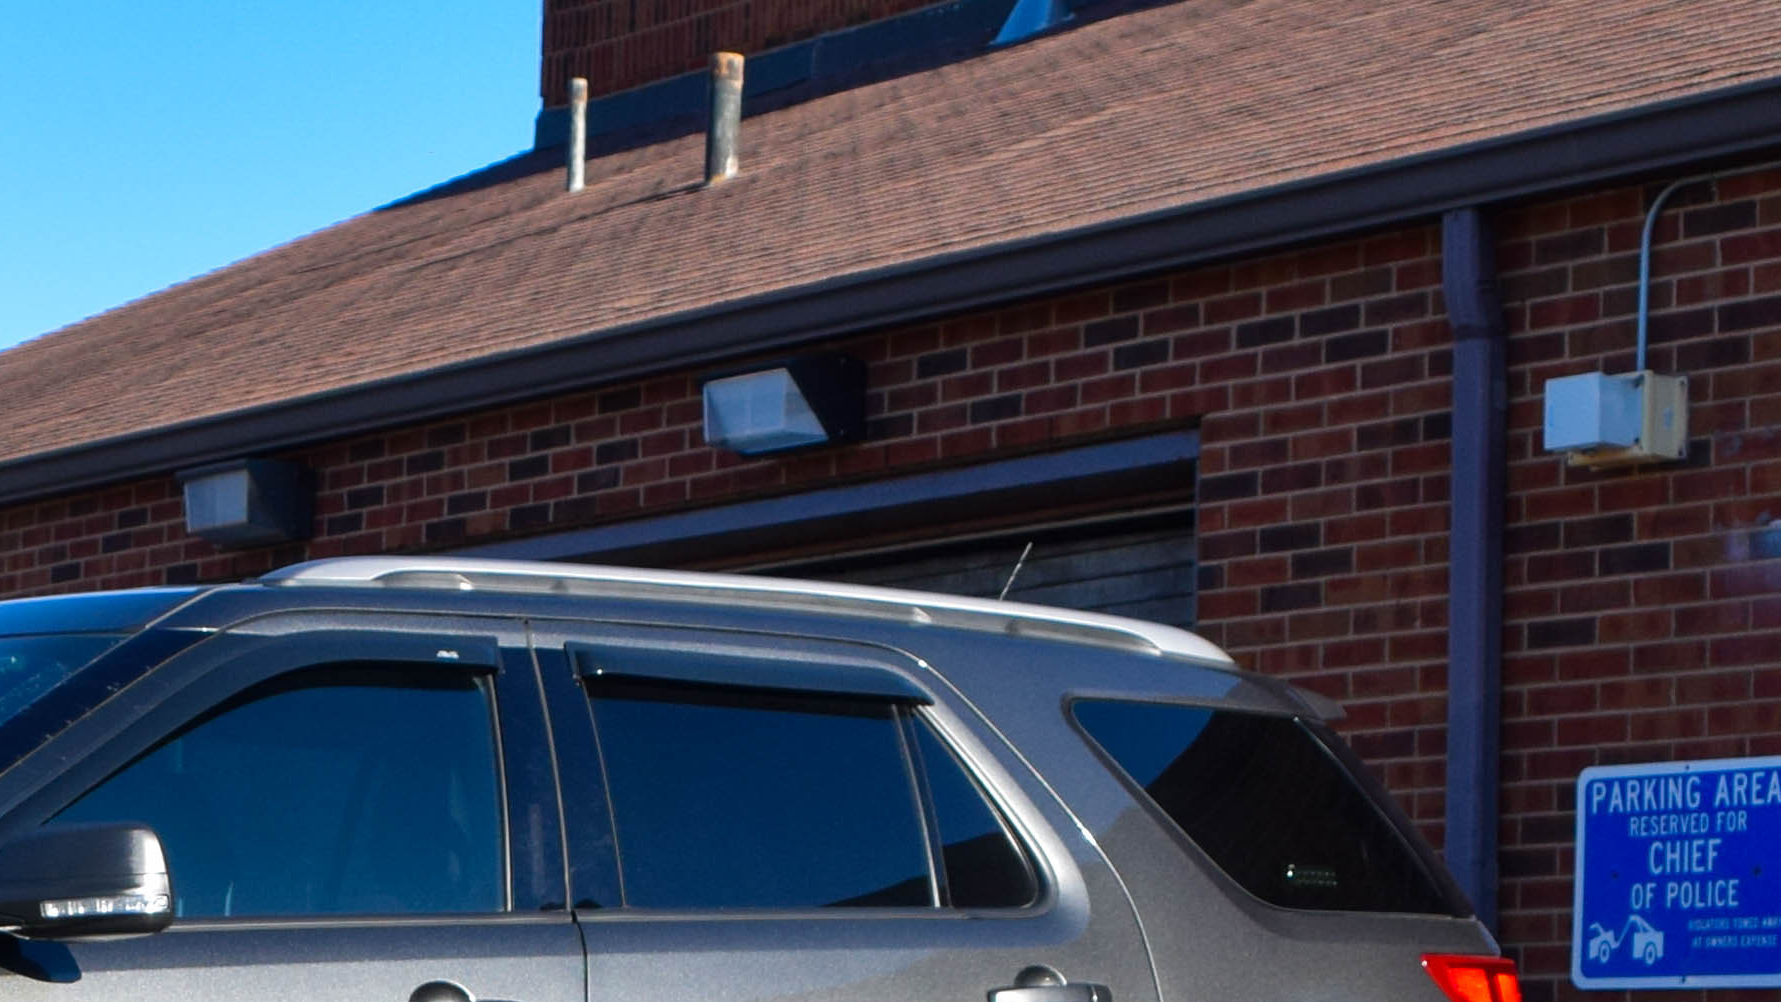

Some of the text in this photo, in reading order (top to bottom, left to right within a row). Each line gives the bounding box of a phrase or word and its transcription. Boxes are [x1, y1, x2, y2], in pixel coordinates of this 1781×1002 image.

[1591, 770, 1781, 814] PARKING AREA
[1629, 810, 1748, 837] RESERVED FOR
[1649, 838, 1722, 875] CHIEF
[1632, 879, 1740, 910] OF POLICE
